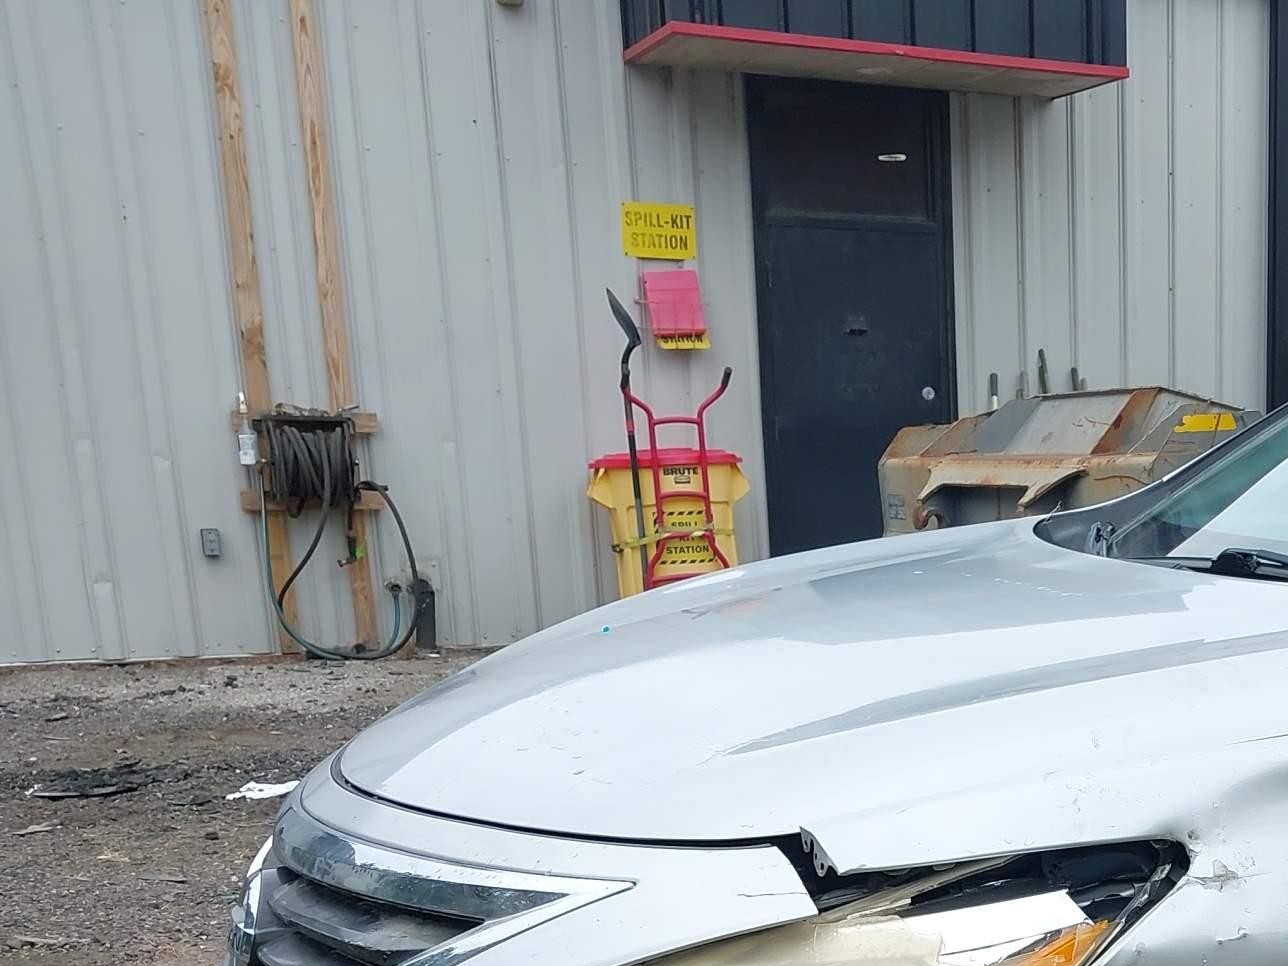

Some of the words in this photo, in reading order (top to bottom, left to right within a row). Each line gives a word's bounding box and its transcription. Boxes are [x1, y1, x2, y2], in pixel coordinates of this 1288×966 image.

[625, 211, 692, 229] SPILL-KIT
[631, 232, 689, 250] STATION
[663, 466, 699, 476] BRUTE
[666, 545, 709, 555] STATION
